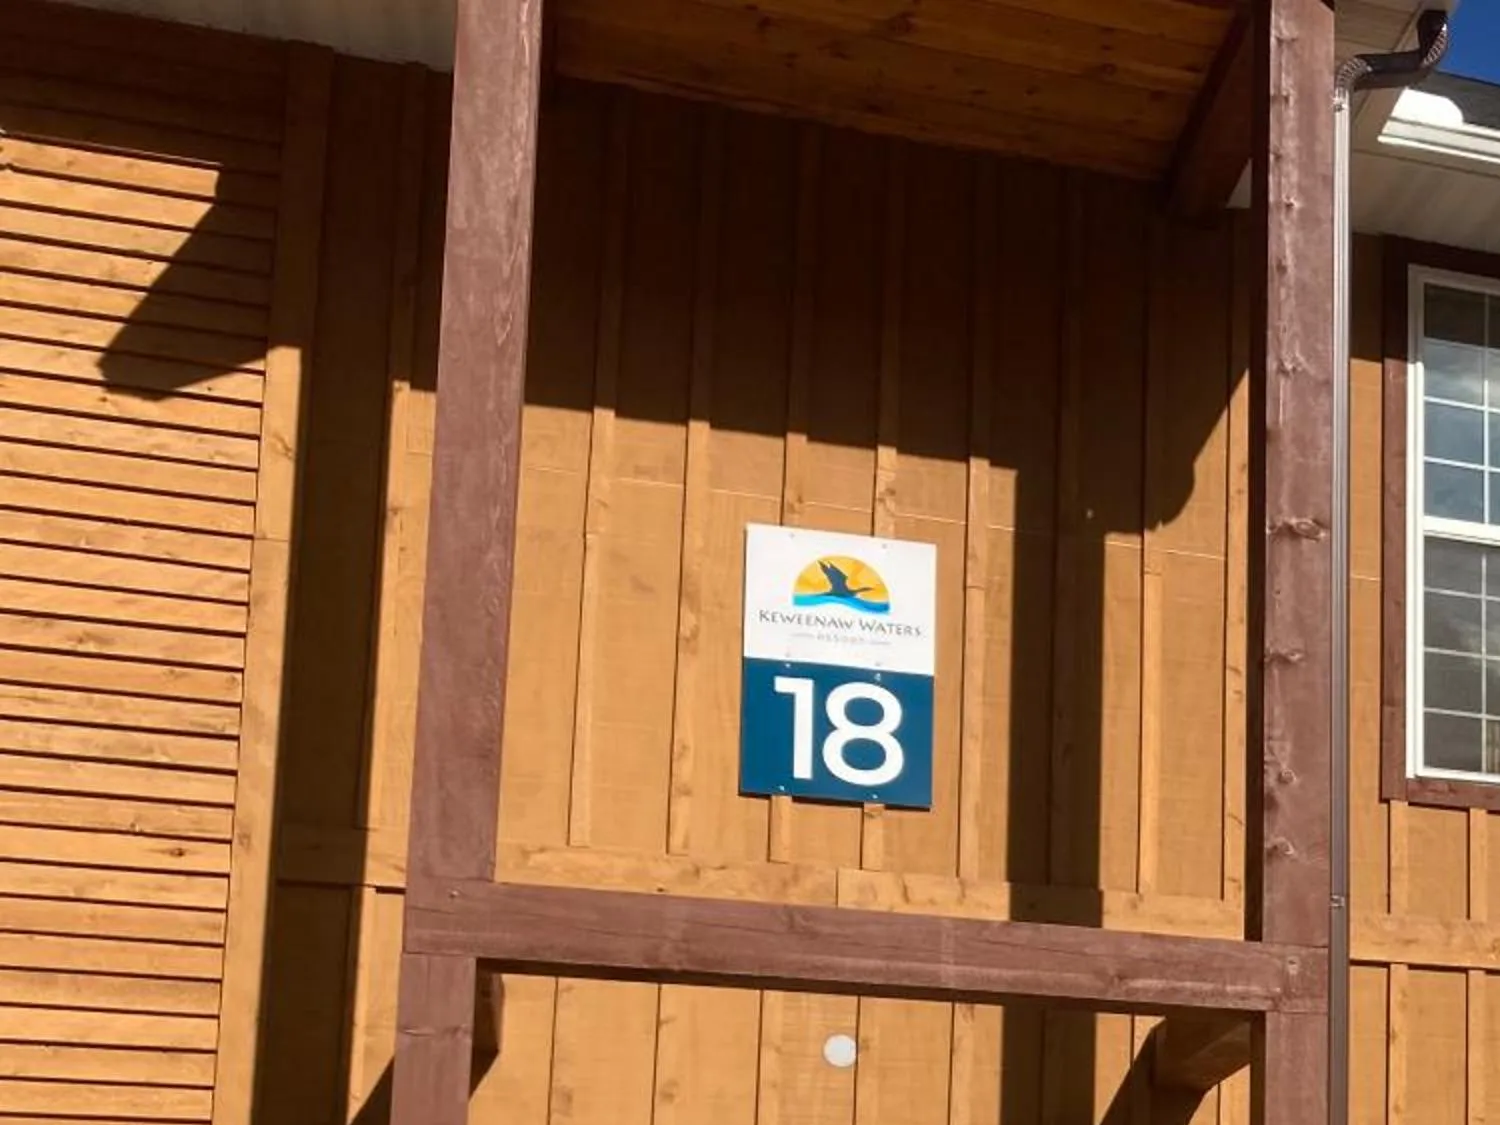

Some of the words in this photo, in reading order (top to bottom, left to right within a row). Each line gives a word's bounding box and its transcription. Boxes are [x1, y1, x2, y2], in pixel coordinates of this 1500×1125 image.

[758, 609, 853, 630] KEWEENAW
[859, 617, 921, 637] WATERS
[774, 676, 904, 786] 18
